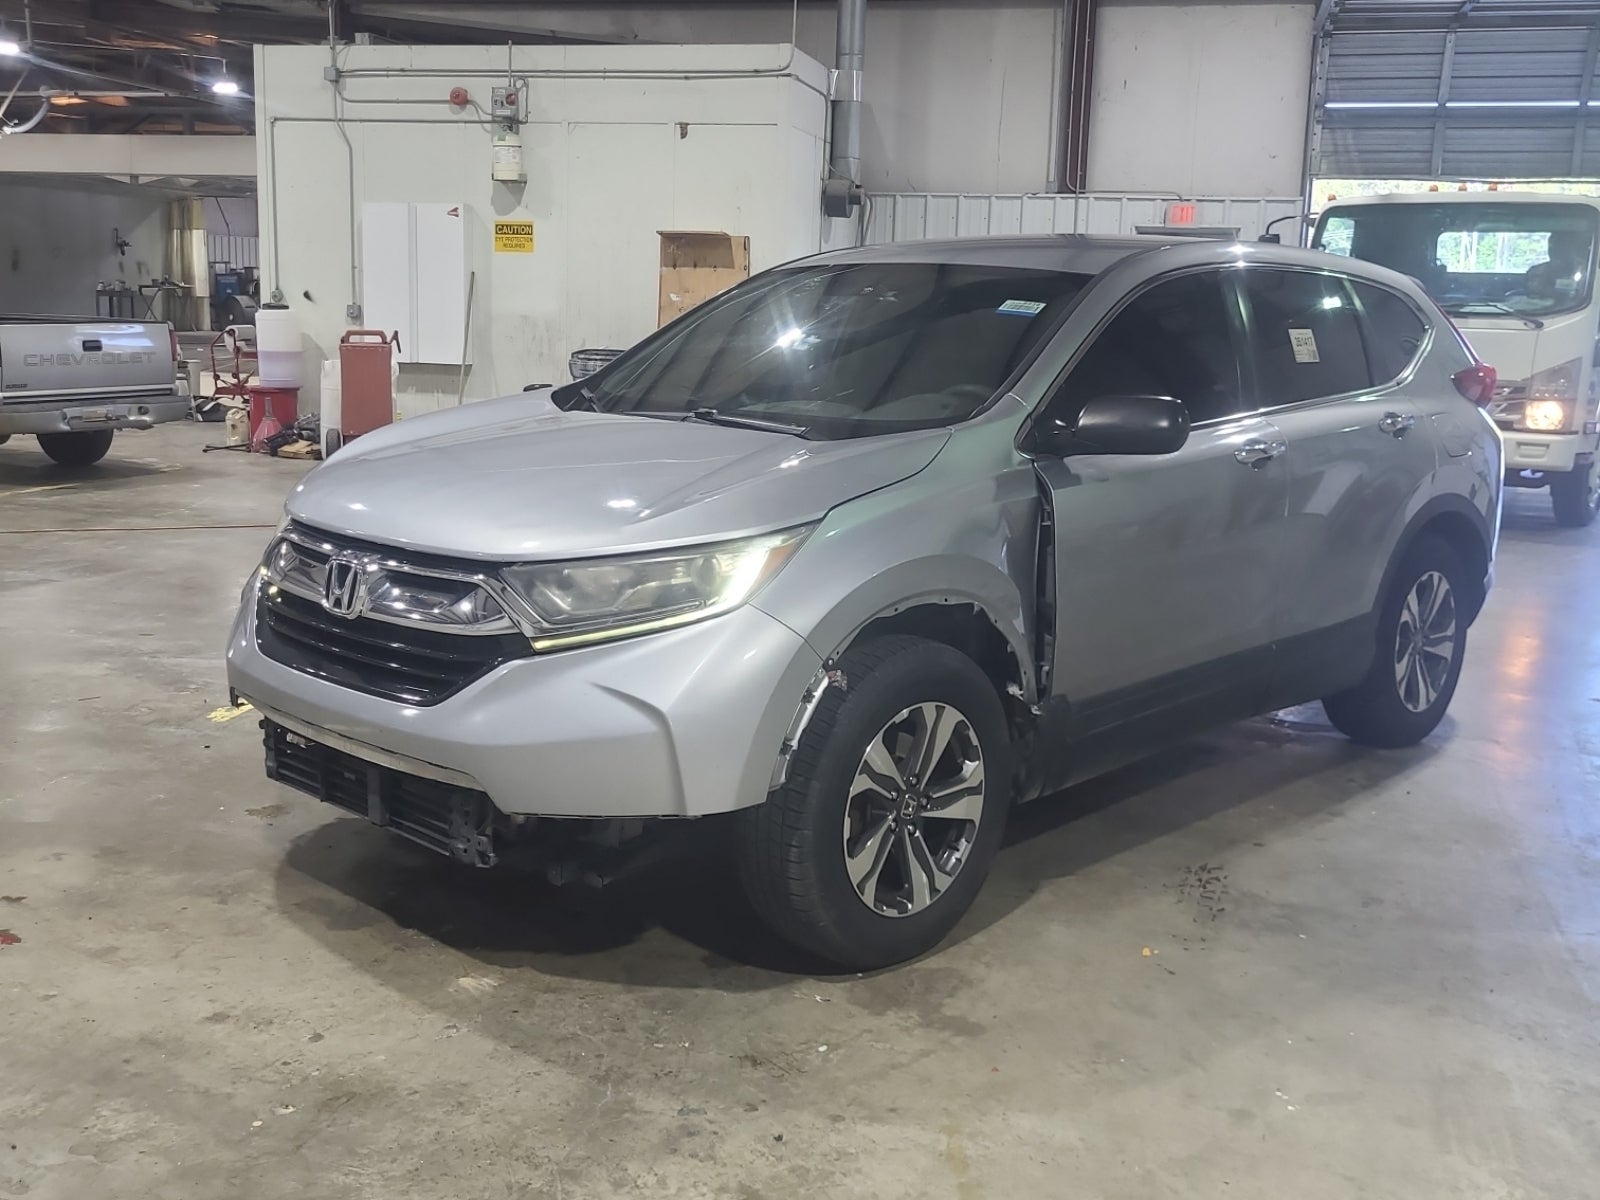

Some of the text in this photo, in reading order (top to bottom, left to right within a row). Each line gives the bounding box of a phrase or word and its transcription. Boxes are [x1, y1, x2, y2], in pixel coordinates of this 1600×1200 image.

[1171, 205, 1195, 223] EXIT
[496, 225, 532, 235] CAUTION
[24, 352, 156, 366] CHEVROLET
